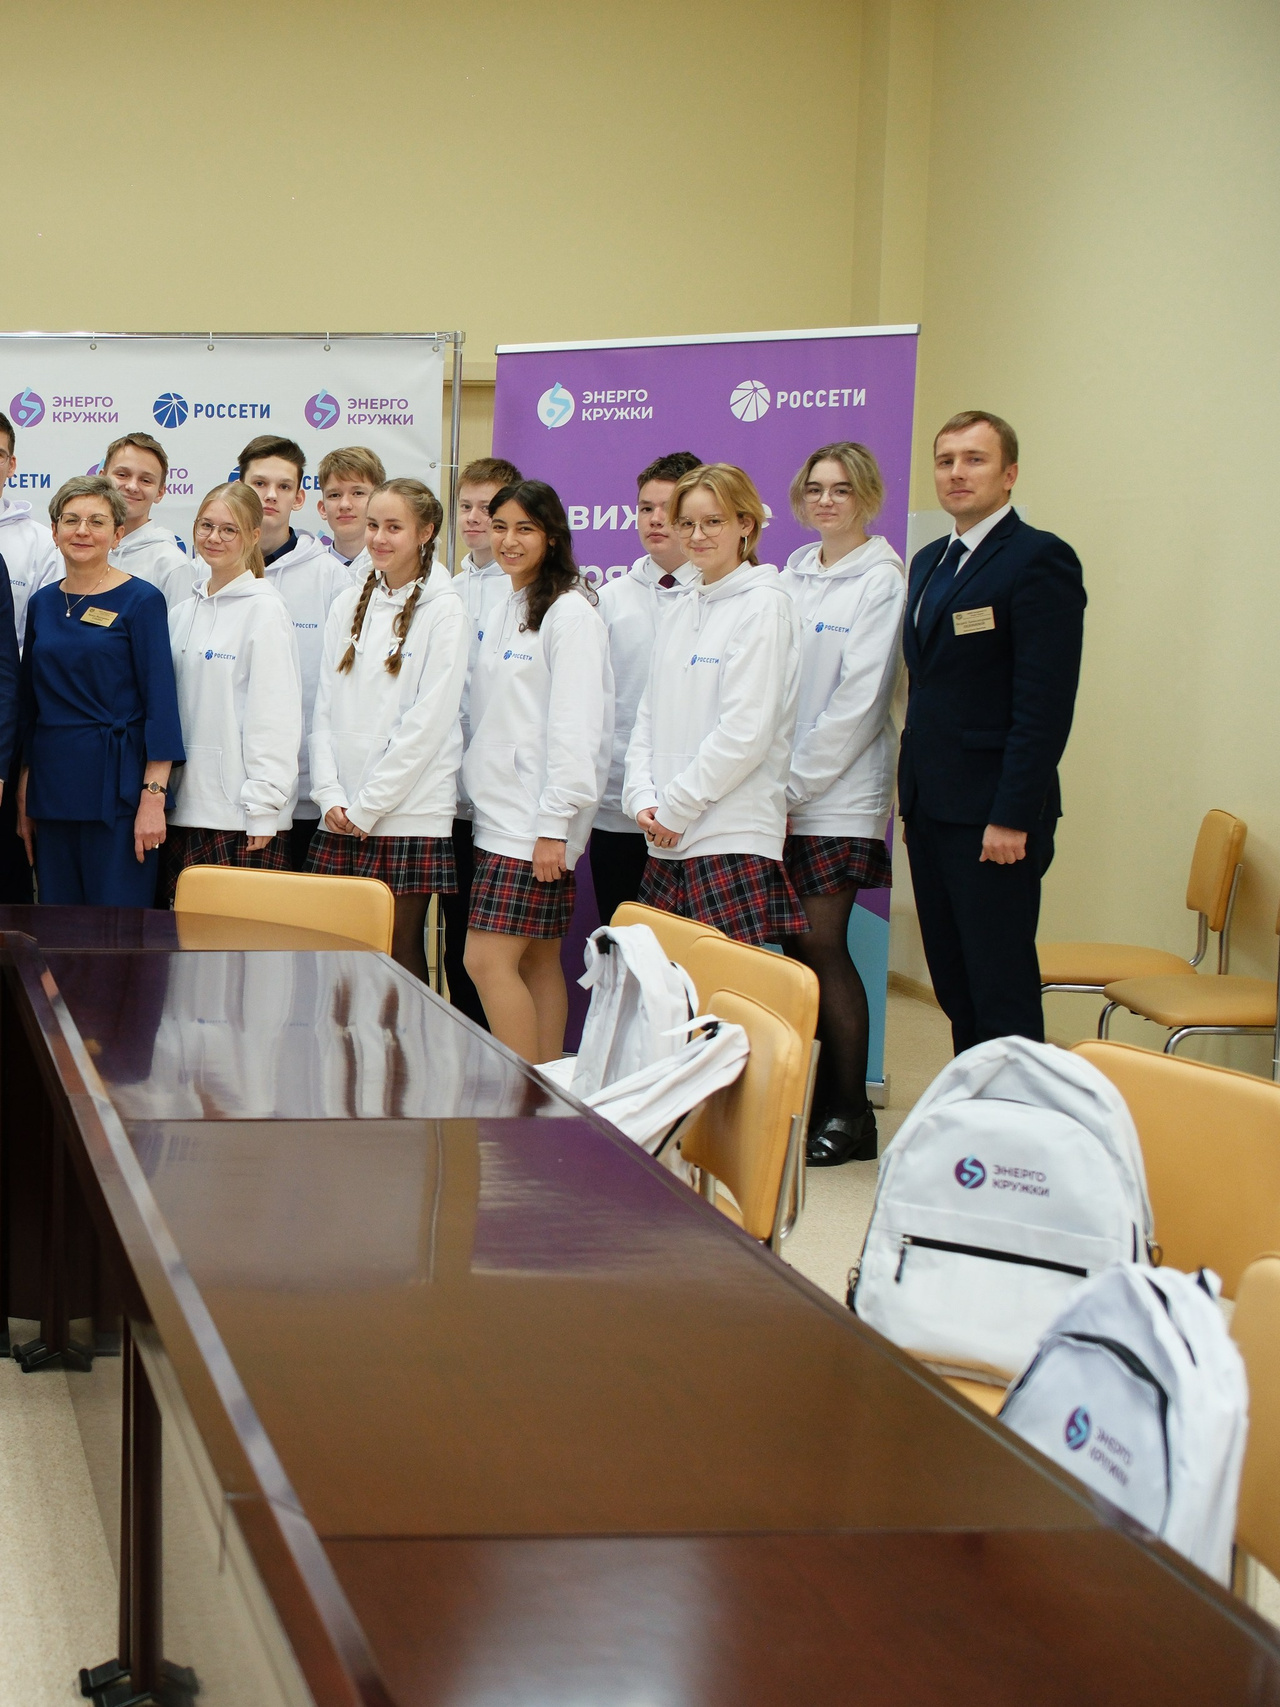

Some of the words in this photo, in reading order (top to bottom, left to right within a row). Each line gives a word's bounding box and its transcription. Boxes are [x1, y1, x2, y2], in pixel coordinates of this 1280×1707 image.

[52, 396, 114, 408] ЭНЕРГО
[581, 388, 648, 404] ЭНЕРГО
[776, 388, 866, 409] РОССЕТИ
[193, 403, 271, 419] РОССЕТИ
[347, 398, 409, 410] ЭНЕРГО
[52, 411, 119, 423] КРУЖКИ
[347, 413, 414, 426] КРУЖКИ
[581, 406, 653, 421] КРУЖКИ
